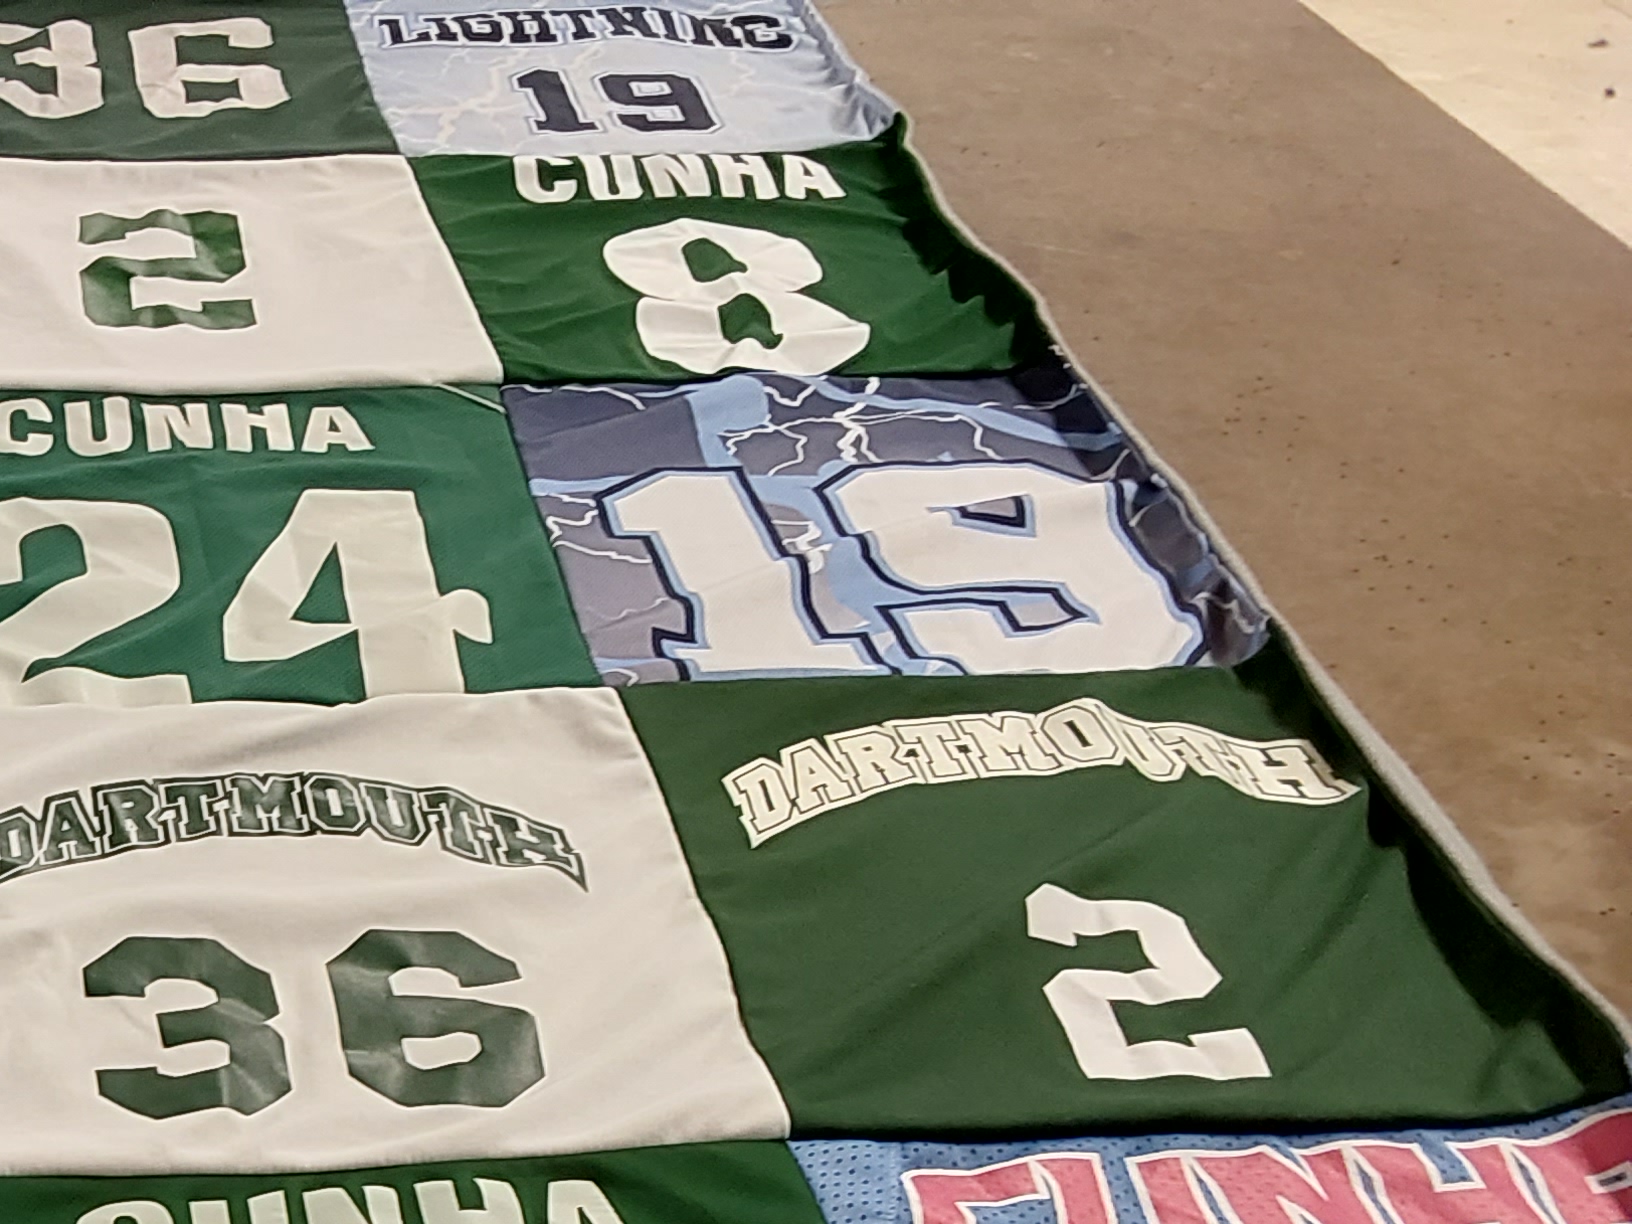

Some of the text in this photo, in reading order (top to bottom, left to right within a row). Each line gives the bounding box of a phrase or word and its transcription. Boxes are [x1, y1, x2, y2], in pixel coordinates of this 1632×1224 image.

[373, 5, 798, 53] LIGHTNING
[513, 66, 723, 136] 19
[513, 154, 848, 204] CUNHA
[77, 208, 258, 331] 2
[602, 217, 870, 376] 8
[595, 460, 1206, 679] 19
[722, 697, 1361, 849] DARTMOUTH
[82, 928, 546, 1120] 36
[1025, 883, 1272, 1081] 2
